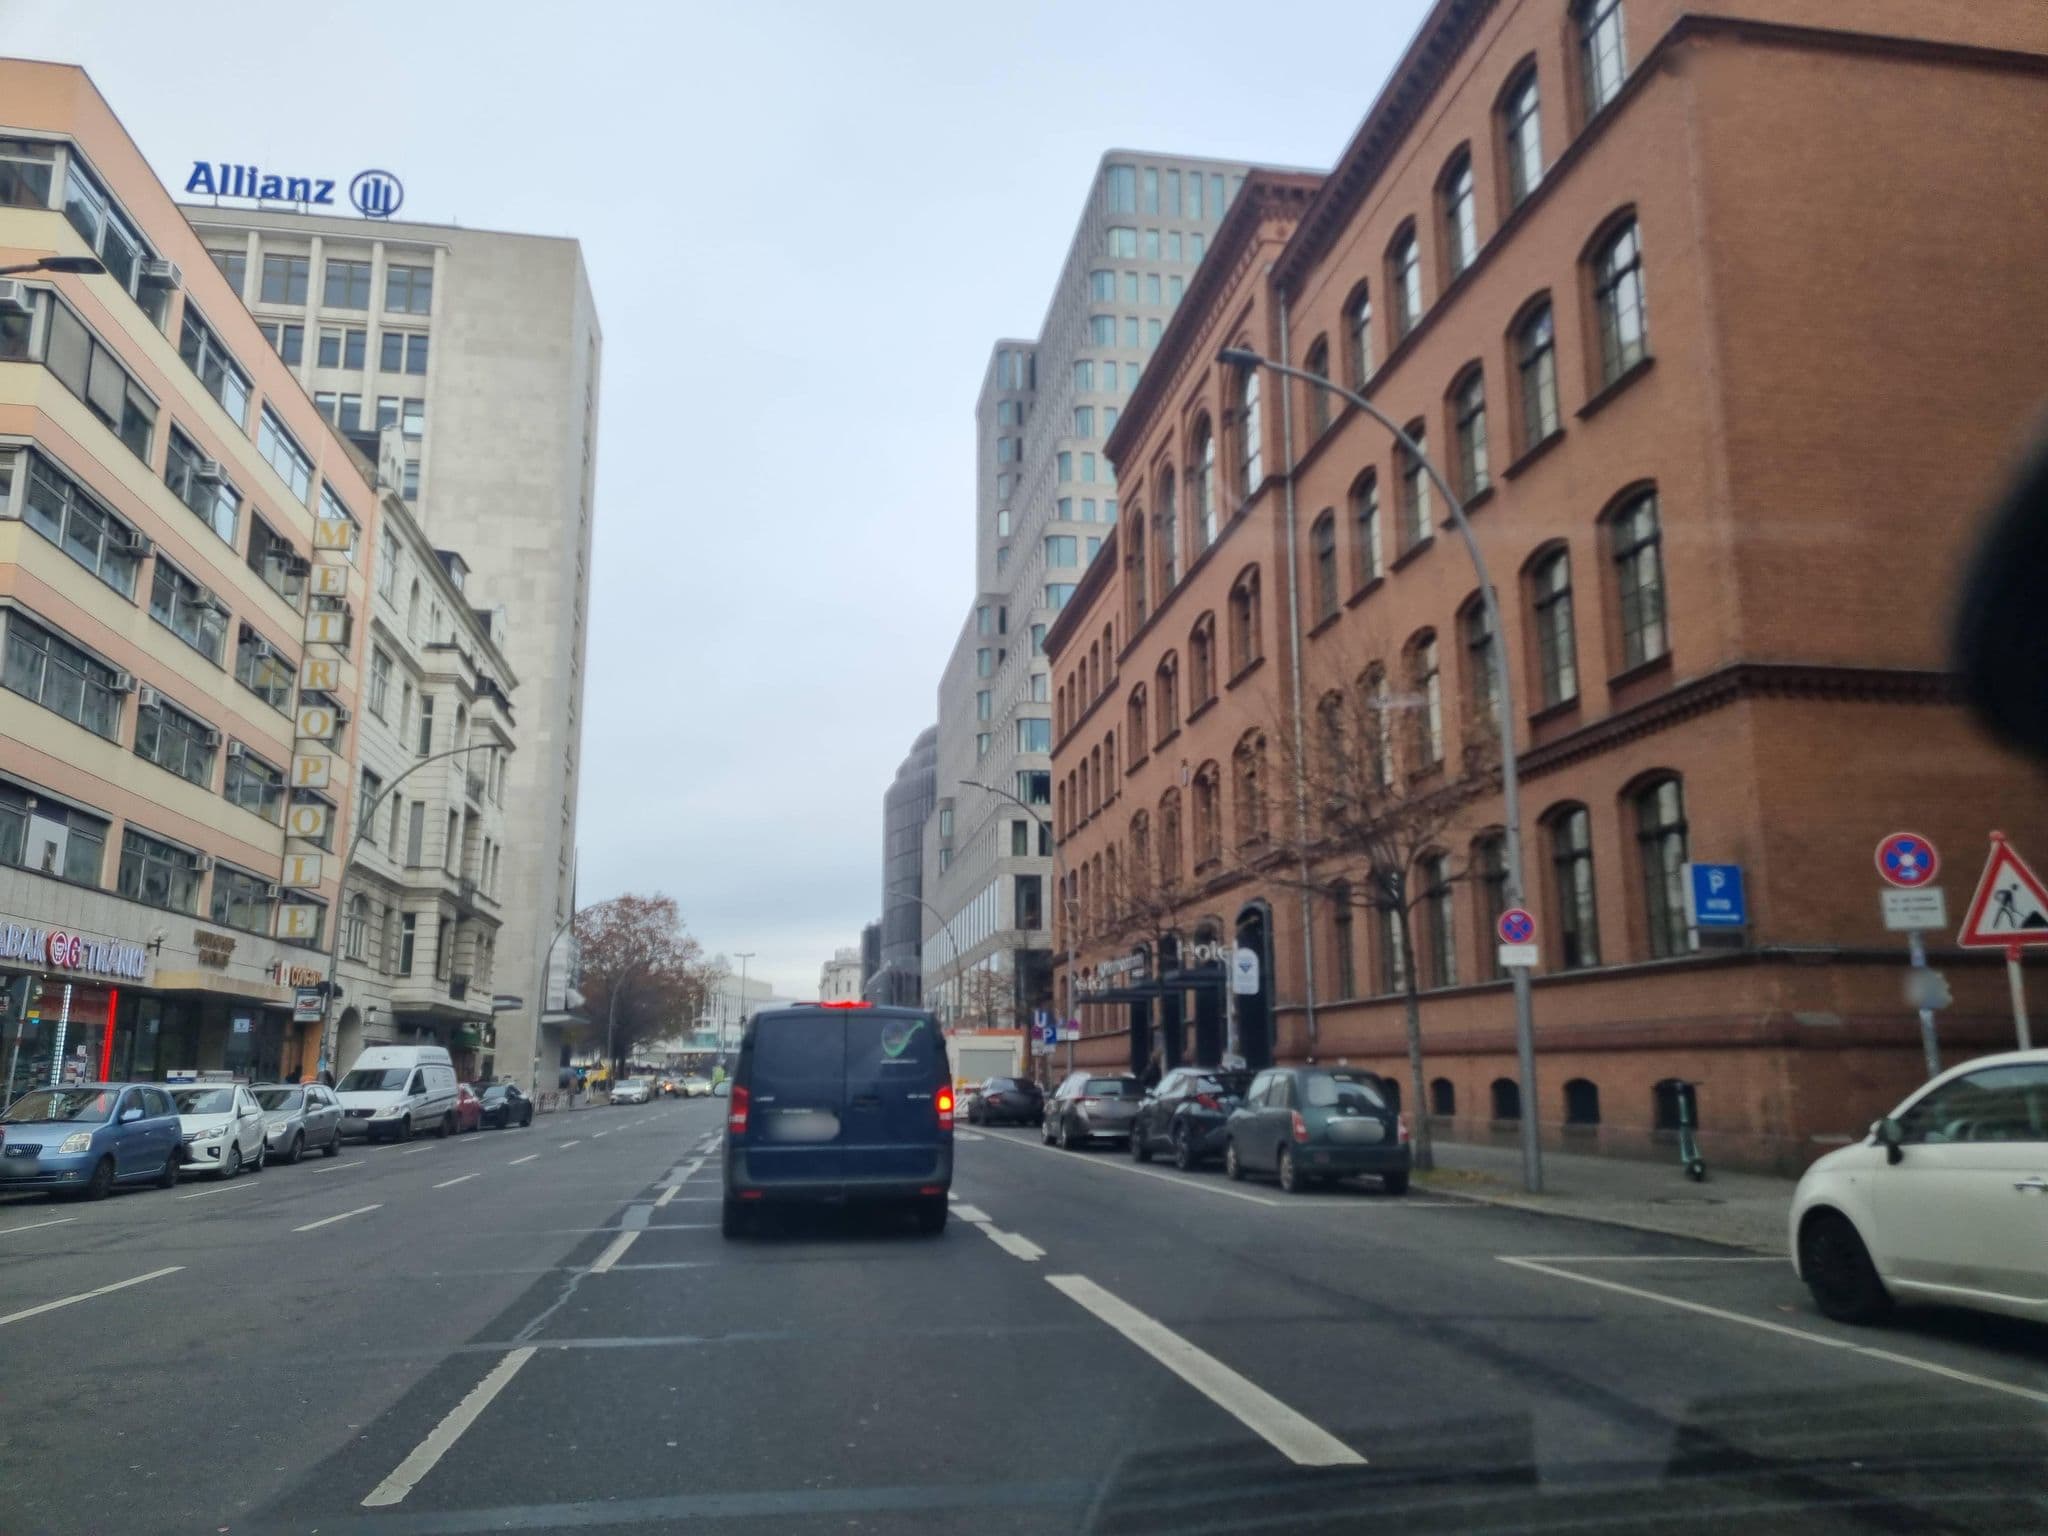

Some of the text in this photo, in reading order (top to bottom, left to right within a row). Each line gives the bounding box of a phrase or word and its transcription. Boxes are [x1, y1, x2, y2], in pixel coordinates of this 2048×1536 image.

[184, 160, 336, 205] Allianz
[287, 520, 350, 937] METROPOLE
[1033, 1009, 1047, 1028] U
[1042, 1027, 1054, 1043] P
